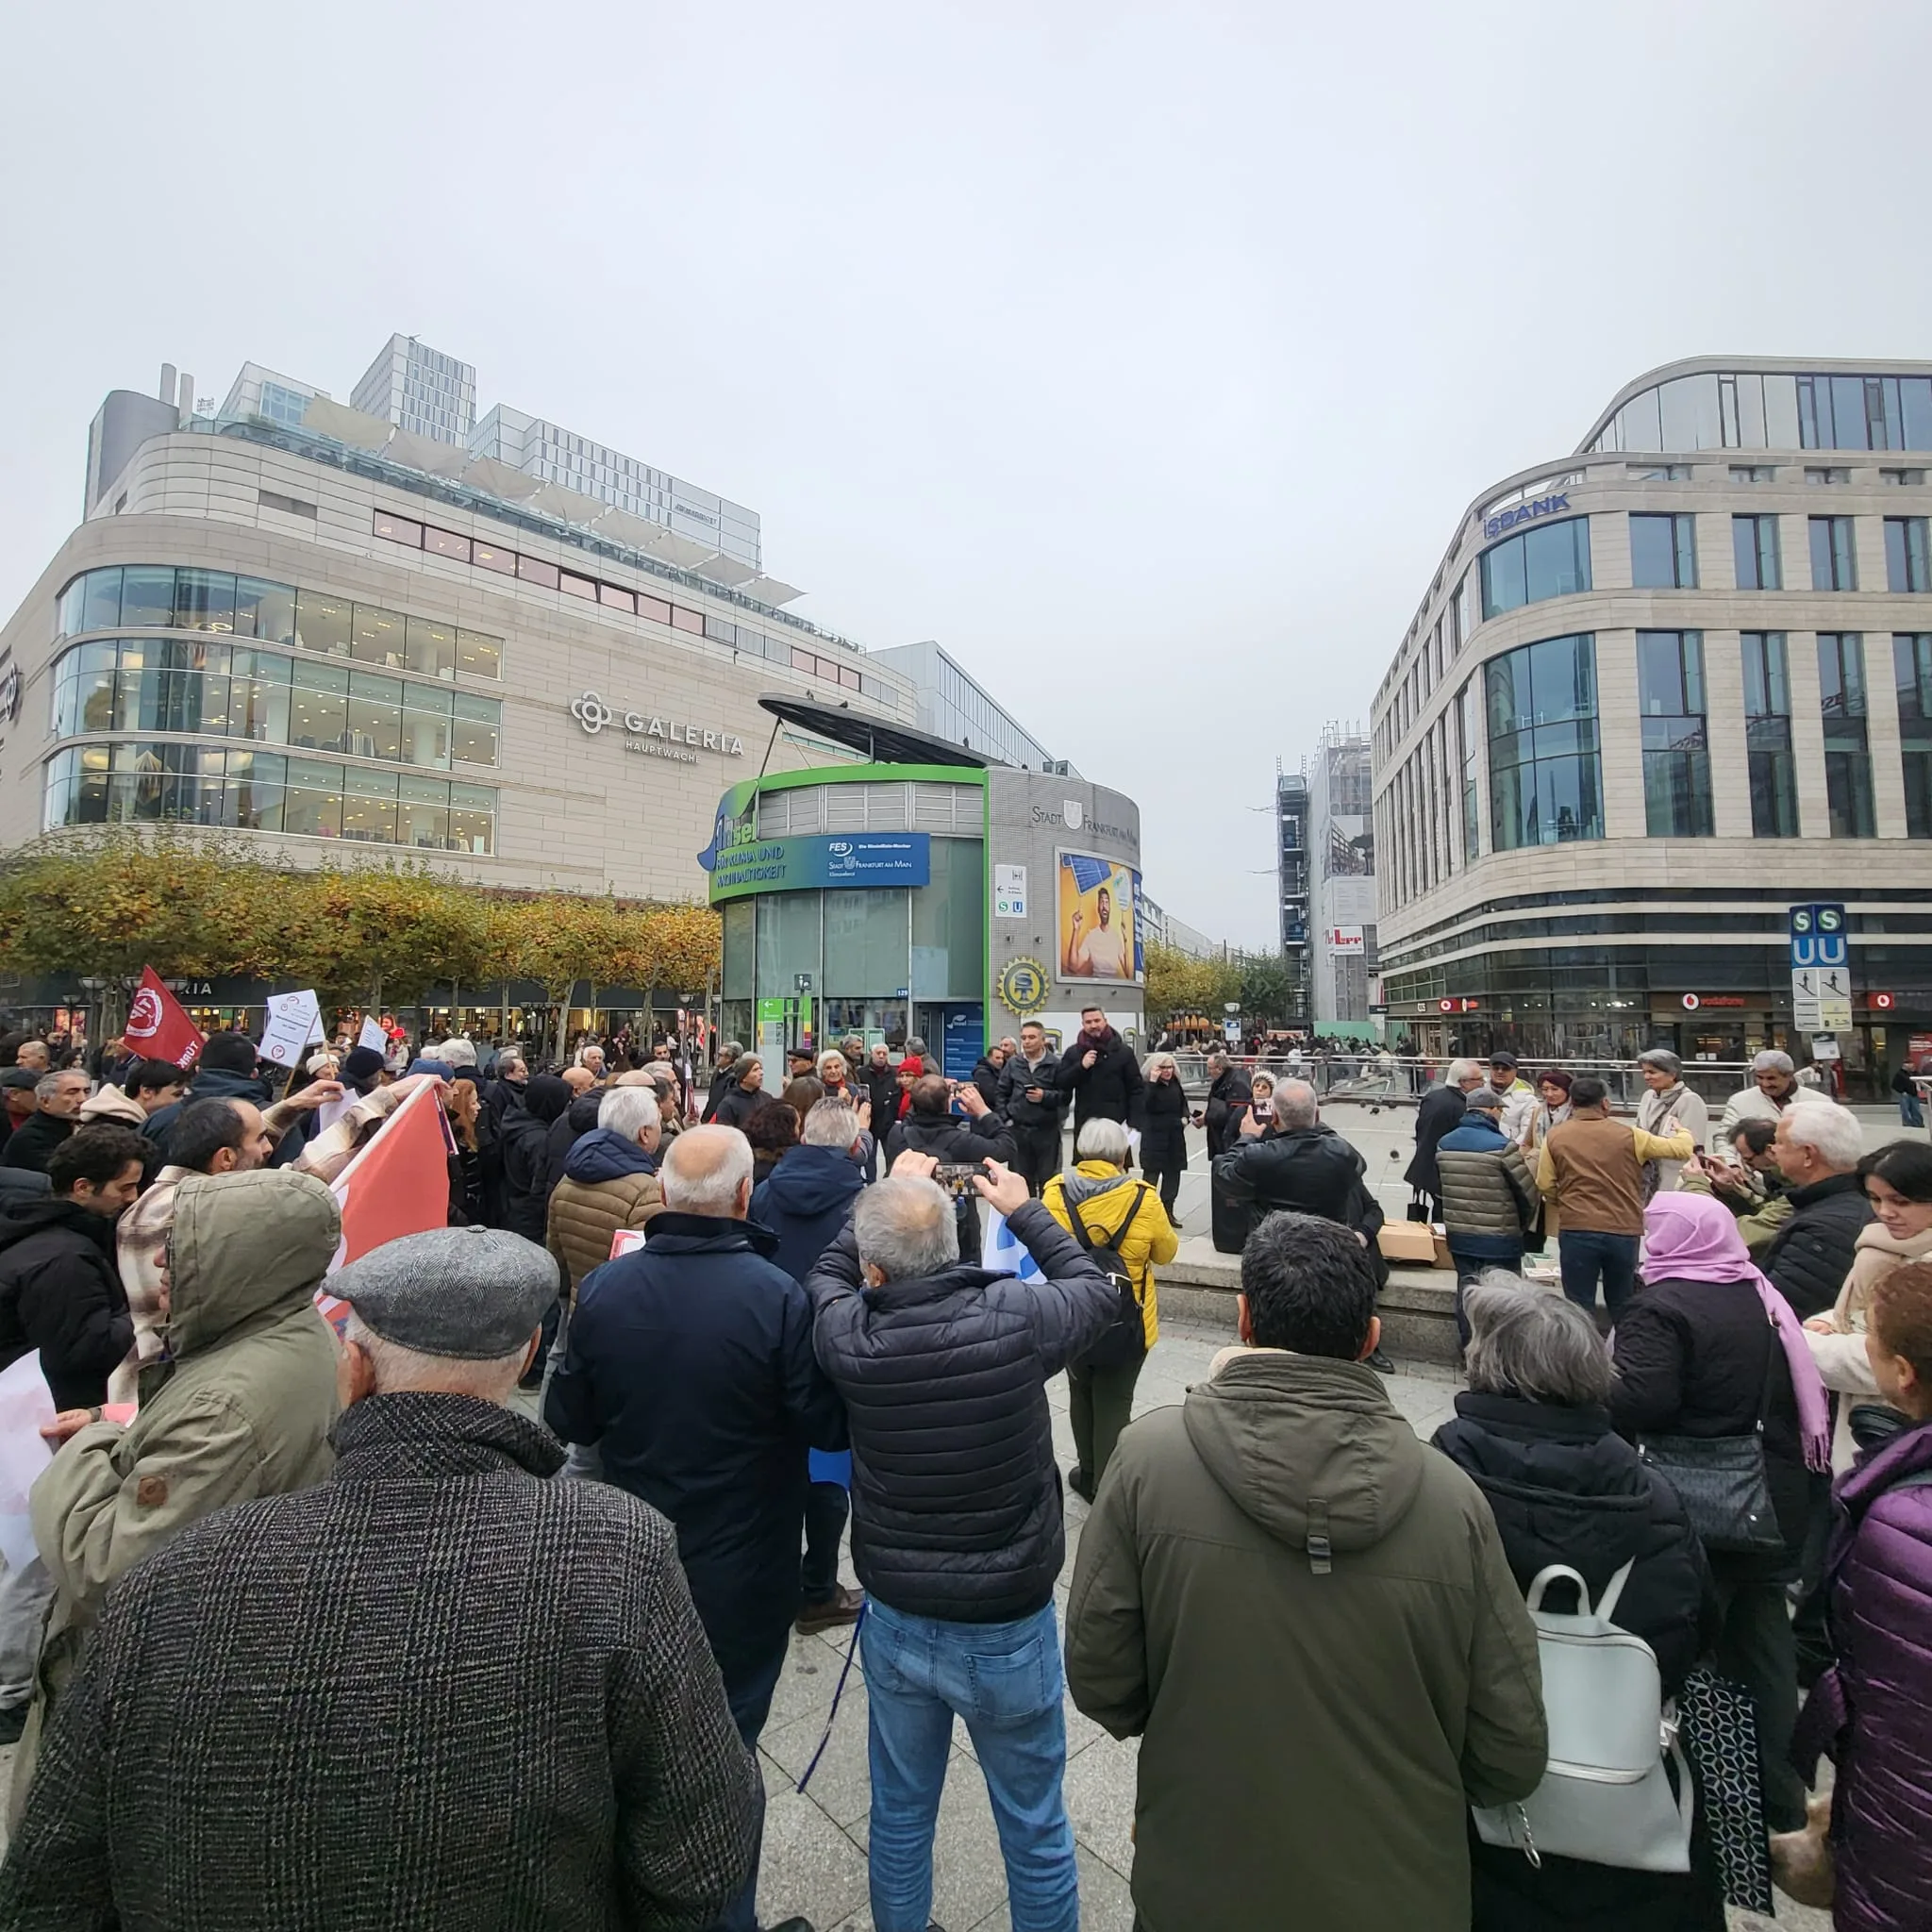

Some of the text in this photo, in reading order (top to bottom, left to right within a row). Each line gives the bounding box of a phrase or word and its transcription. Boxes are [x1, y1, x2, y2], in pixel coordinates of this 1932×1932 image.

[624, 711, 744, 756] GALERIA
[625, 740, 702, 763] HAUPTWACHE
[758, 844, 785, 862] UND
[829, 842, 847, 852] FES
[1795, 911, 1837, 931] S S
[1793, 938, 1845, 964] U U
